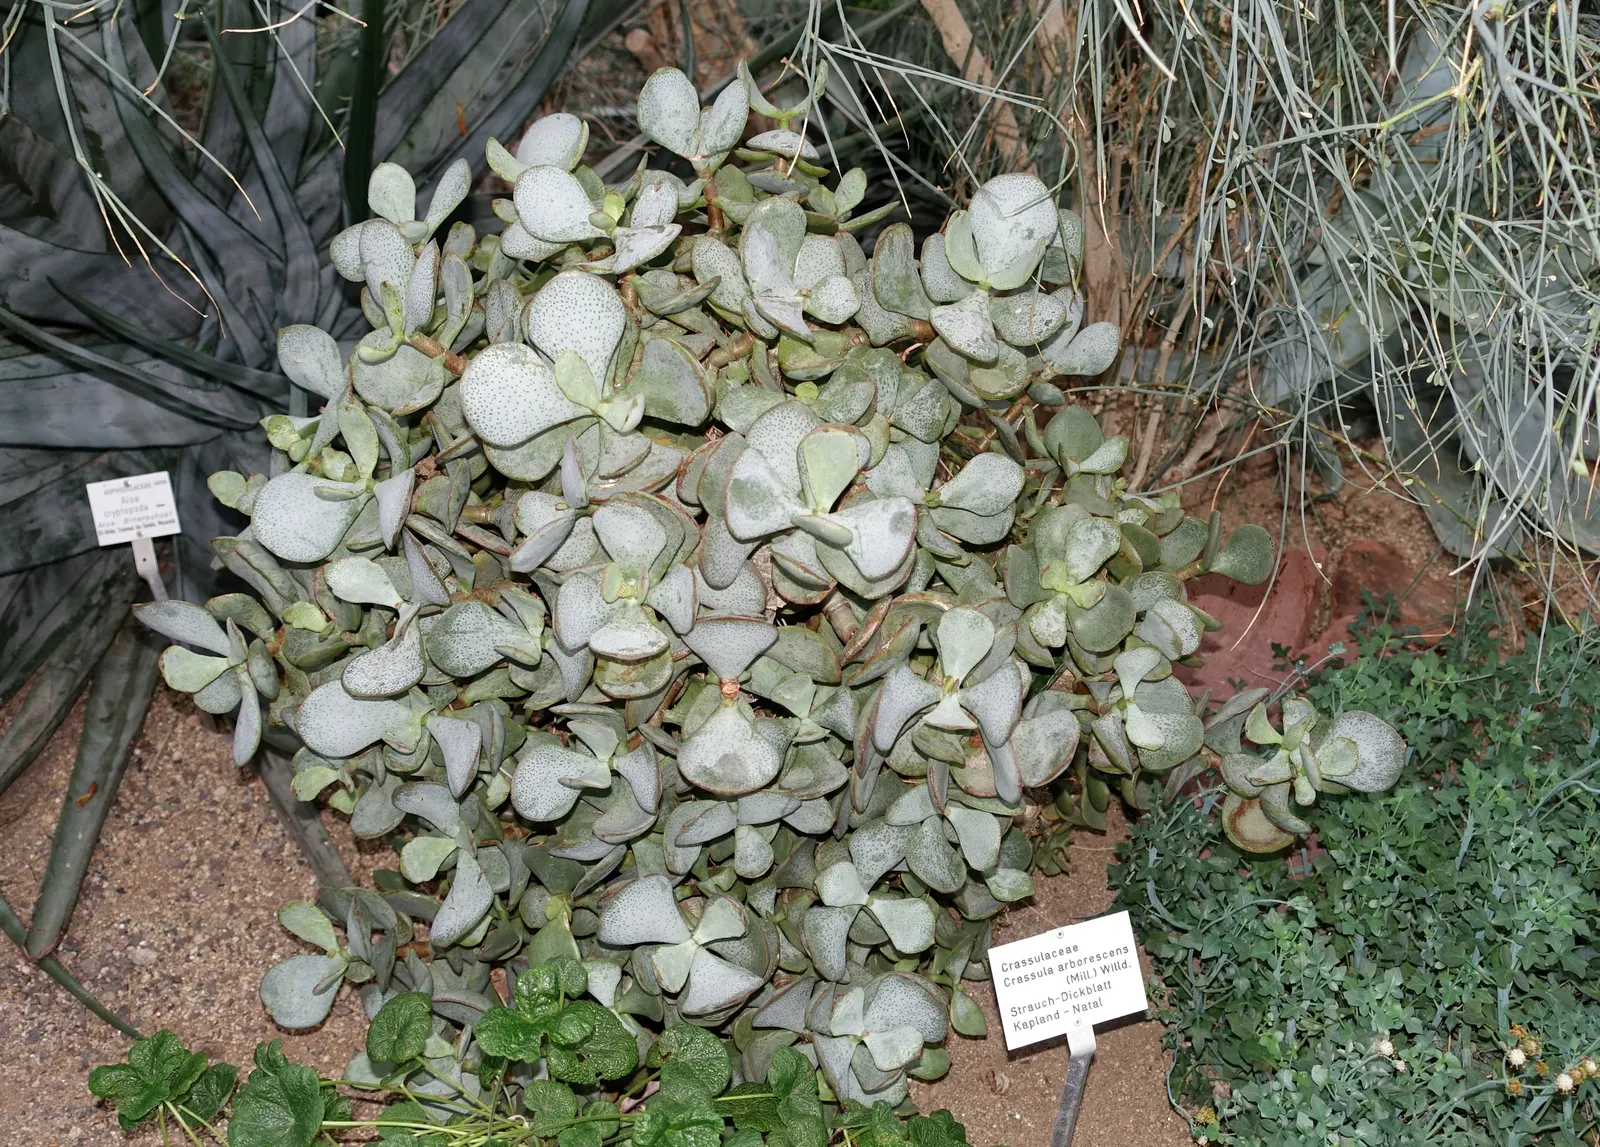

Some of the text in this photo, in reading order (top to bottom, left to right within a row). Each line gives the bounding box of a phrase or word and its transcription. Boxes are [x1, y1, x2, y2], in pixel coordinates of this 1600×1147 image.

[1001, 944, 1079, 972] Crassulaceae
[1004, 945, 1129, 987] Crassula arborescens
[1066, 960, 1131, 985] (Mill.) Willd.
[1010, 981, 1112, 1017] Strauch-Dickblatt
[1013, 1011, 1060, 1032] Kapland
[1073, 998, 1103, 1014] Natal
